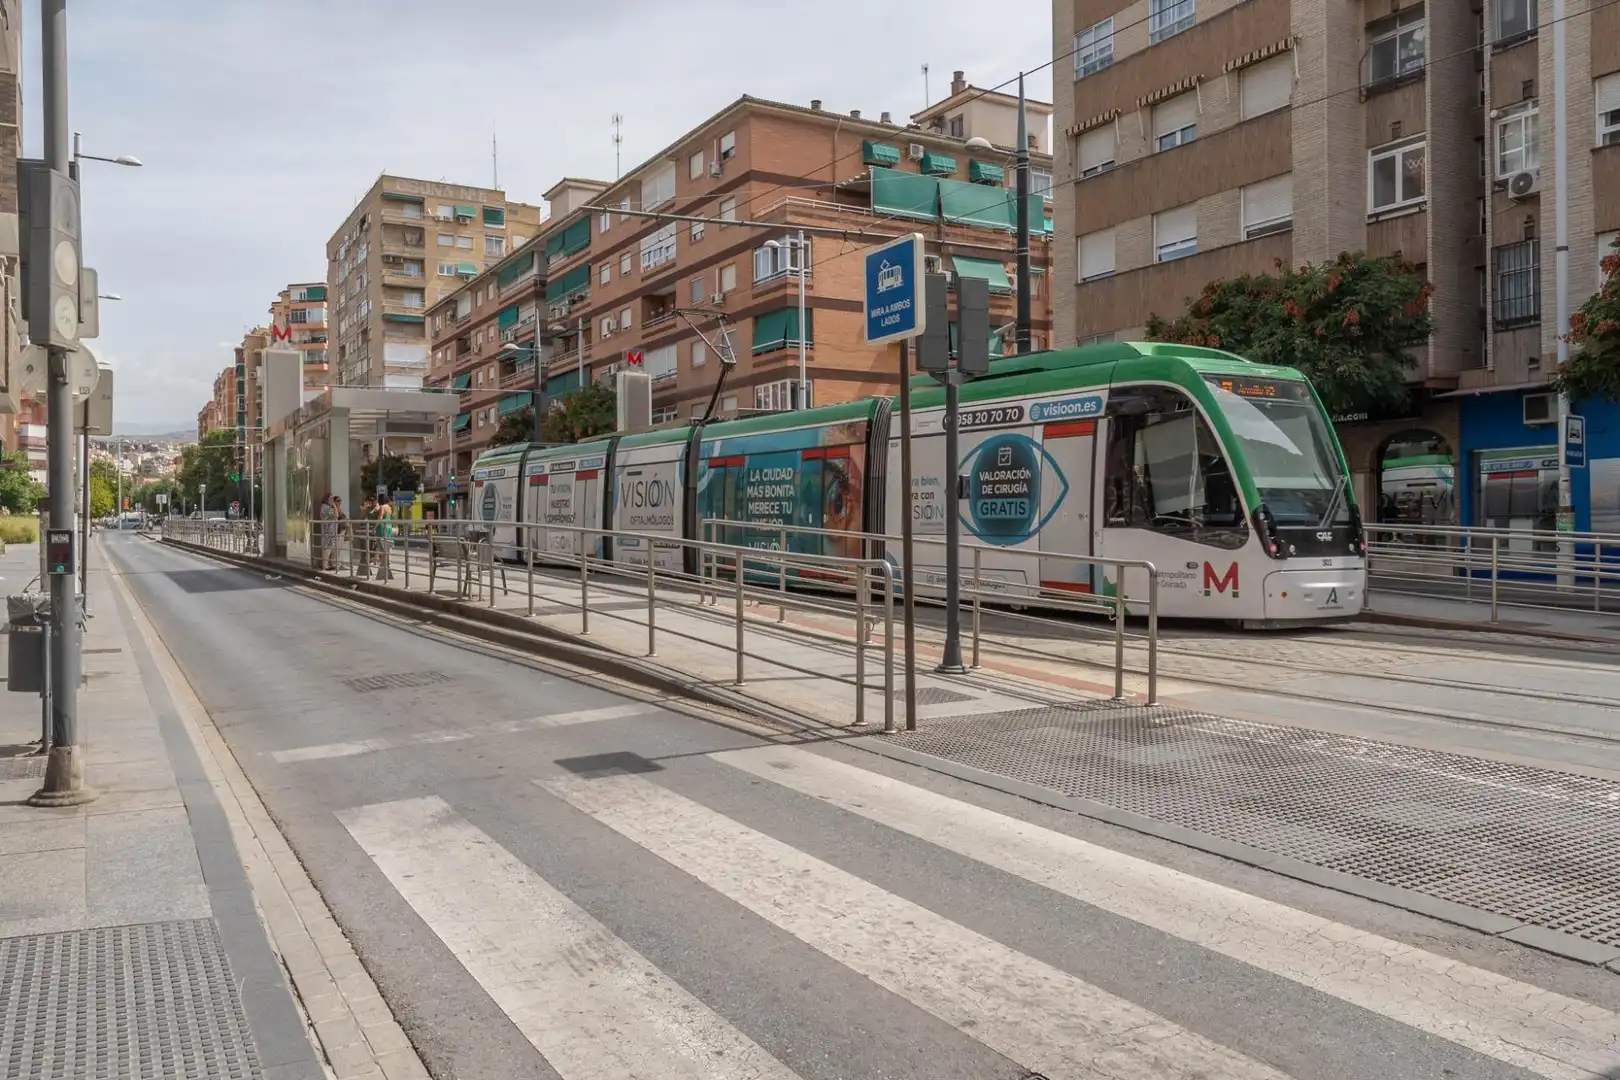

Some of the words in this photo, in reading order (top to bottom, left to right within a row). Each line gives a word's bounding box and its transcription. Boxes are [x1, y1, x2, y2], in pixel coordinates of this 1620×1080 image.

[871, 306, 884, 318] MIRA
[890, 299, 910, 313] AMBOS
[881, 313, 900, 326] LADOS
[272, 325, 292, 341] M
[626, 351, 642, 365] M
[975, 411, 988, 424] 20
[990, 409, 1003, 423] 70
[1005, 408, 1019, 421] 70
[1043, 400, 1097, 417] visioon.es
[750, 469, 761, 481] LA
[762, 468, 793, 481] CIUDAD
[979, 467, 1031, 481] VALORACIÓN
[621, 473, 674, 508] VISIÓN
[747, 483, 764, 498] MÁS
[765, 484, 795, 497] BONITA
[920, 490, 935, 500] con
[981, 484, 994, 494] DE
[994, 481, 1029, 495] CIRUGÍA
[748, 501, 780, 514] MERECE
[781, 501, 793, 514] TU
[913, 502, 945, 520] SIÓN
[980, 501, 1027, 516] GRATIS
[1316, 532, 1333, 542] CAF
[1203, 561, 1239, 598] M
